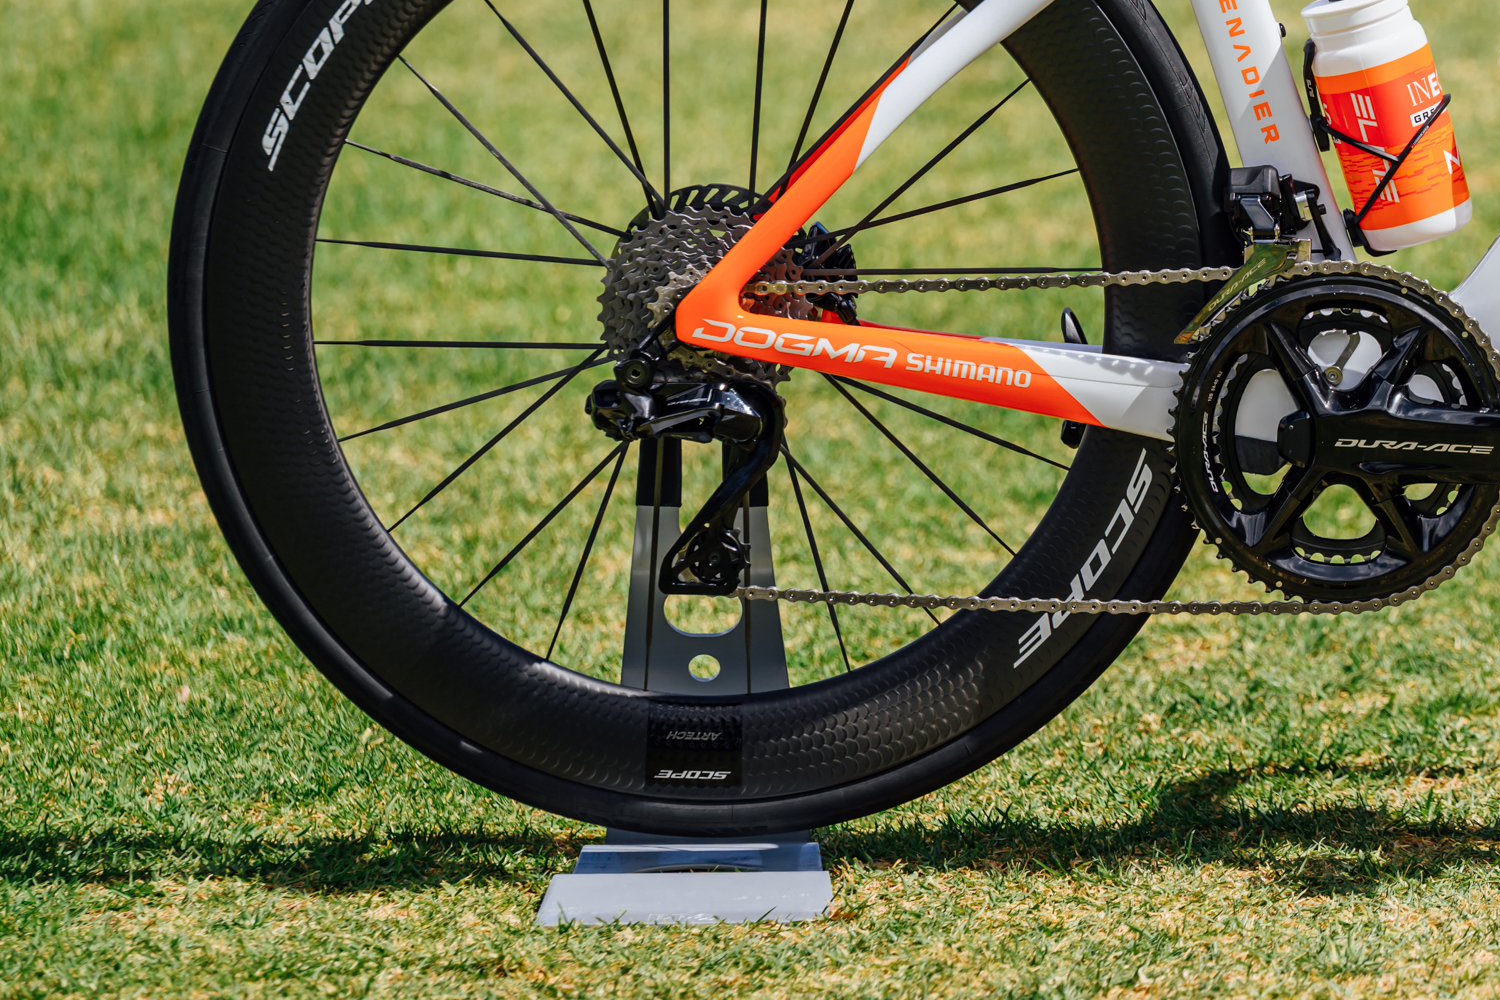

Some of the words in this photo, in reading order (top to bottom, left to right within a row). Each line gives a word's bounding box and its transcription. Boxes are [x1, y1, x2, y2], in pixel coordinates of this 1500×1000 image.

[1406, 69, 1443, 107] INE
[1208, 257, 1266, 311] DURA-ACE
[692, 319, 897, 368] DOGMA
[905, 352, 1032, 388] SHIMANO
[1202, 411, 1219, 493] DURA-ACE
[1334, 438, 1495, 455] DURA-ACE
[1013, 448, 1153, 669] SCOPE
[665, 731, 722, 741] ARTECH
[653, 769, 732, 780] SCOPE
